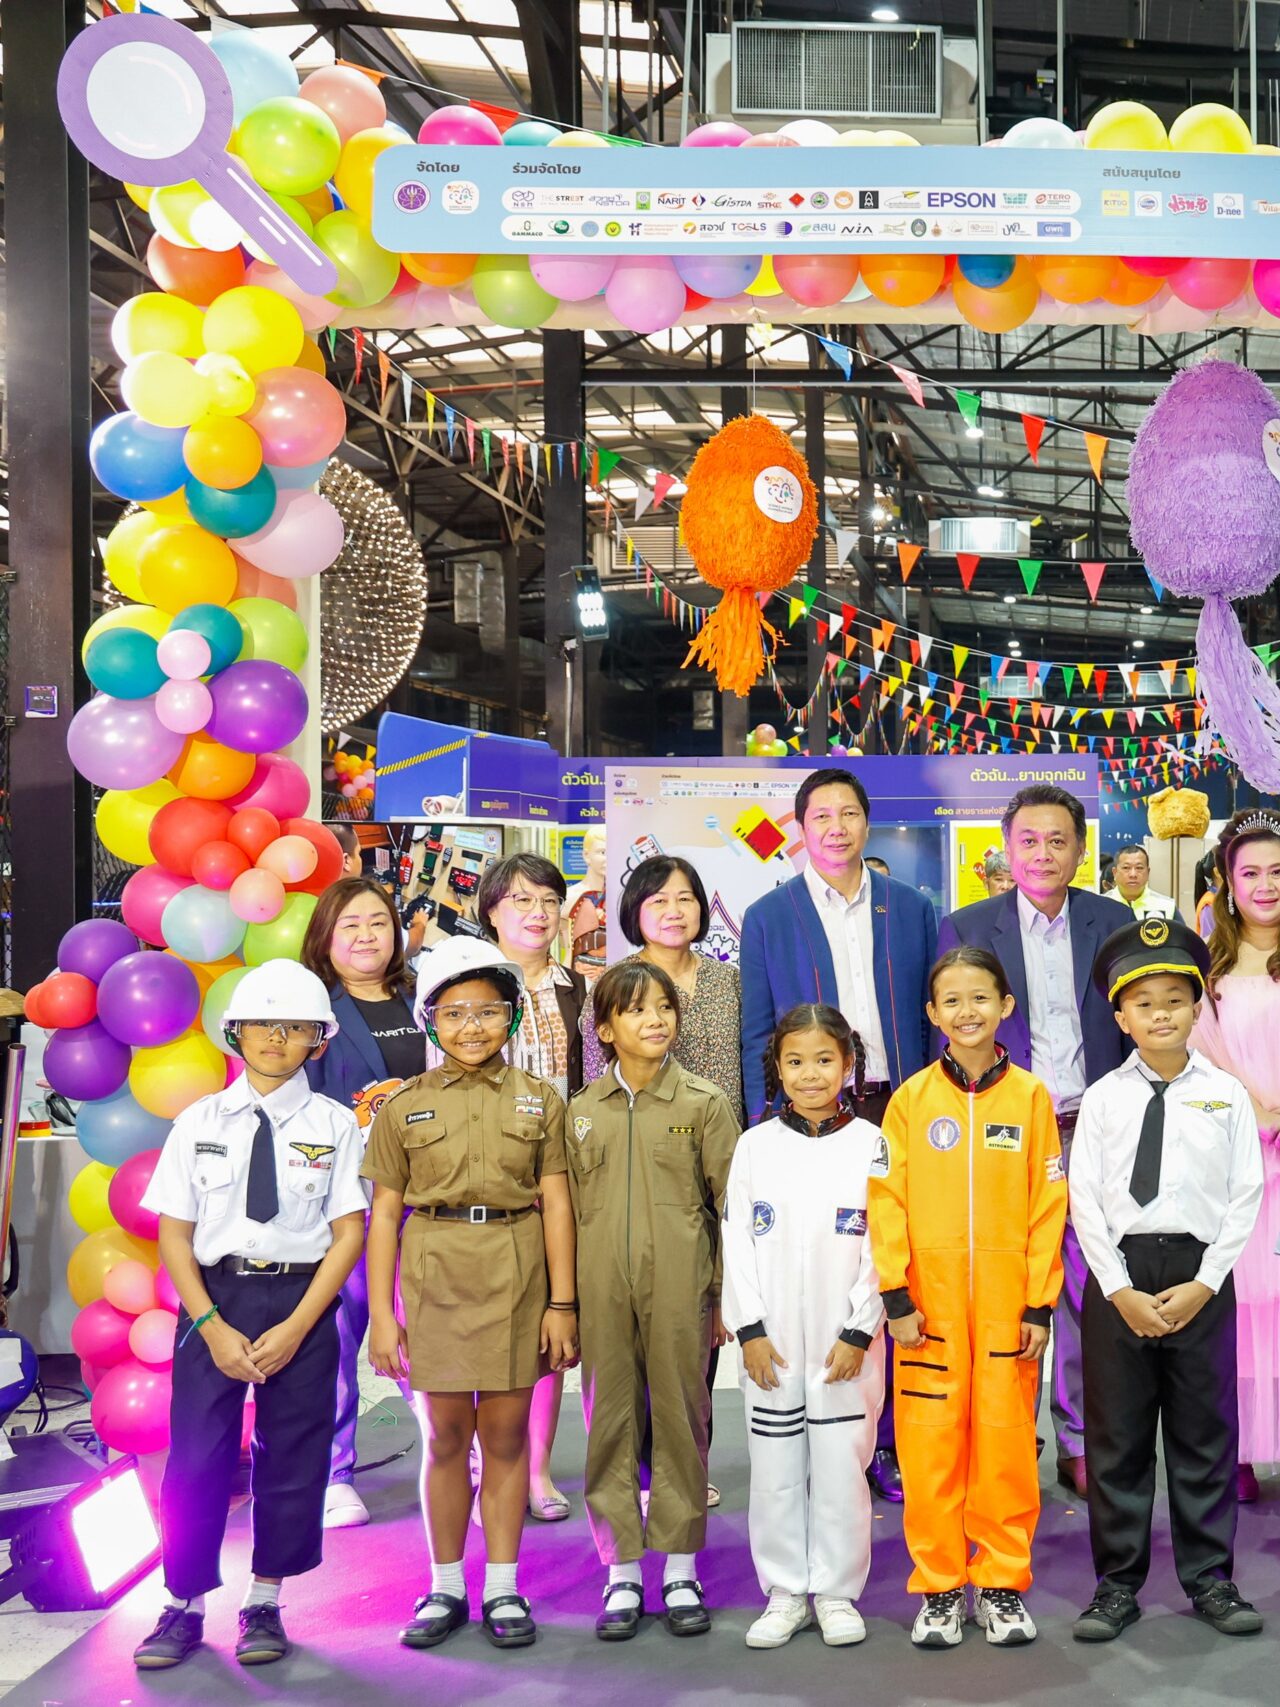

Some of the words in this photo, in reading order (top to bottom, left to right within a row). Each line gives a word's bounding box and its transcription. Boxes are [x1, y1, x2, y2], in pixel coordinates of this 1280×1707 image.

[416, 160, 460, 173] จัดโดย
[512, 162, 582, 175] ร่วมจัดโดย
[1102, 166, 1181, 180] สนับสนุนโดย
[927, 192, 996, 208] EPSON
[970, 768, 1086, 784] ตัวฉัน...ยามฉุกเฉิน
[934, 807, 954, 816] เลือด
